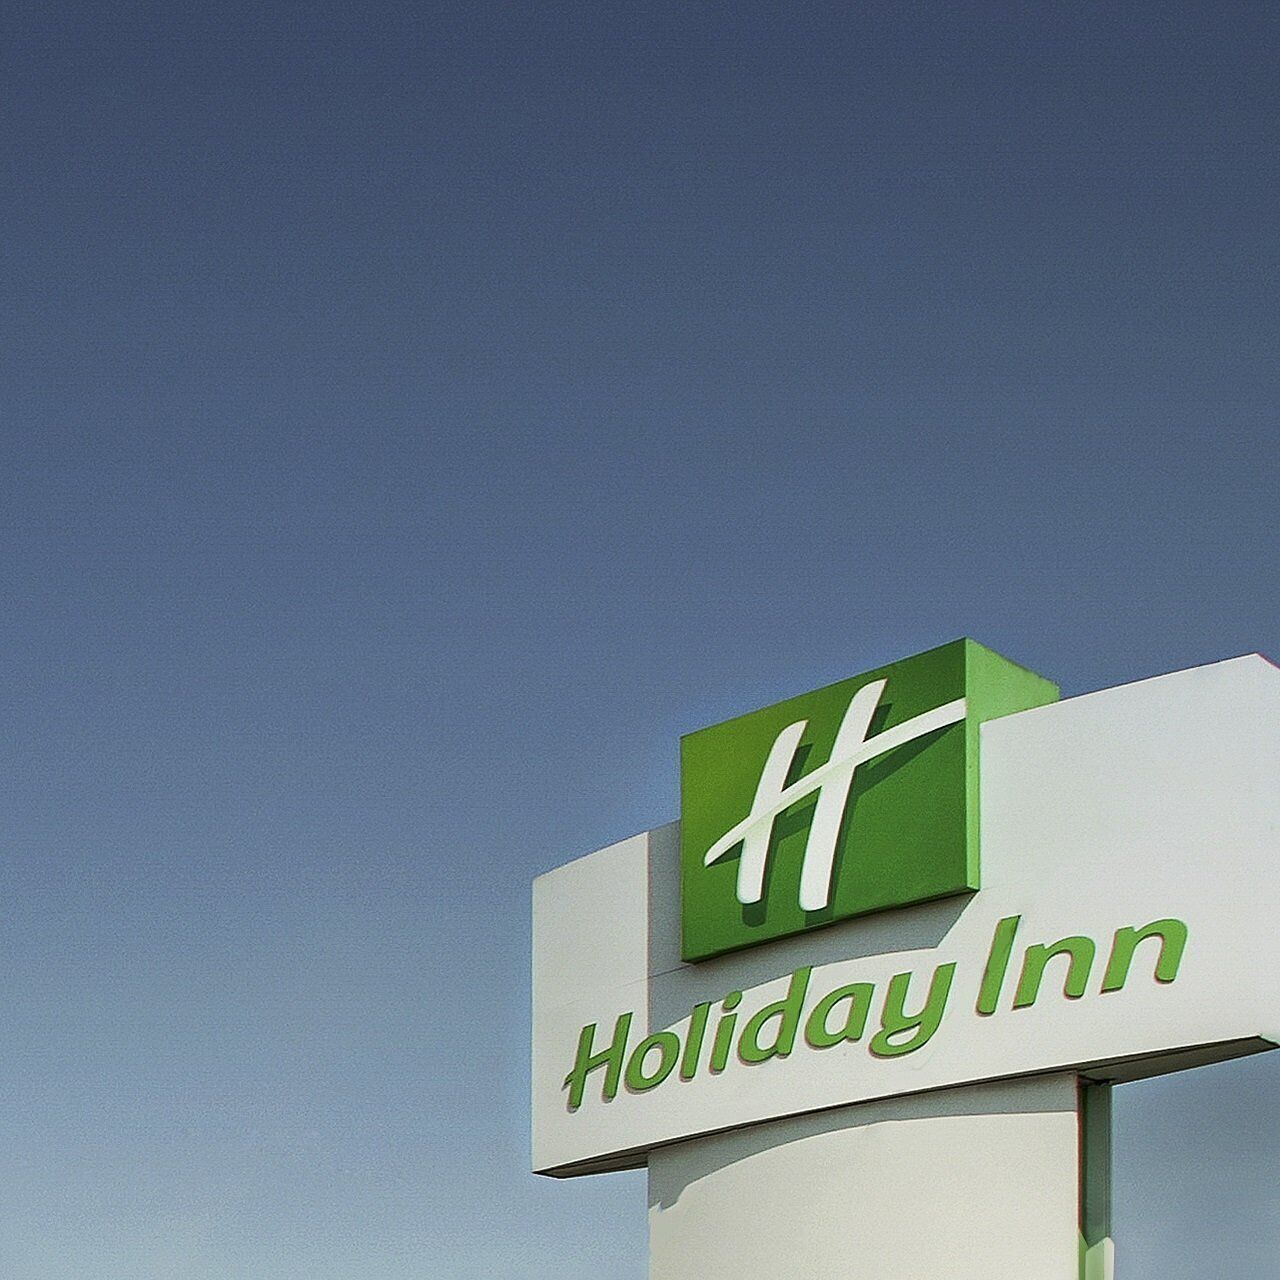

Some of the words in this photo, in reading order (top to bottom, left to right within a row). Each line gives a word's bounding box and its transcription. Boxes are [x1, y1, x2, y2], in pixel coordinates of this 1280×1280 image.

[704, 678, 966, 911] H
[563, 961, 956, 1111] Holiday
[976, 914, 1188, 1015] Inn
